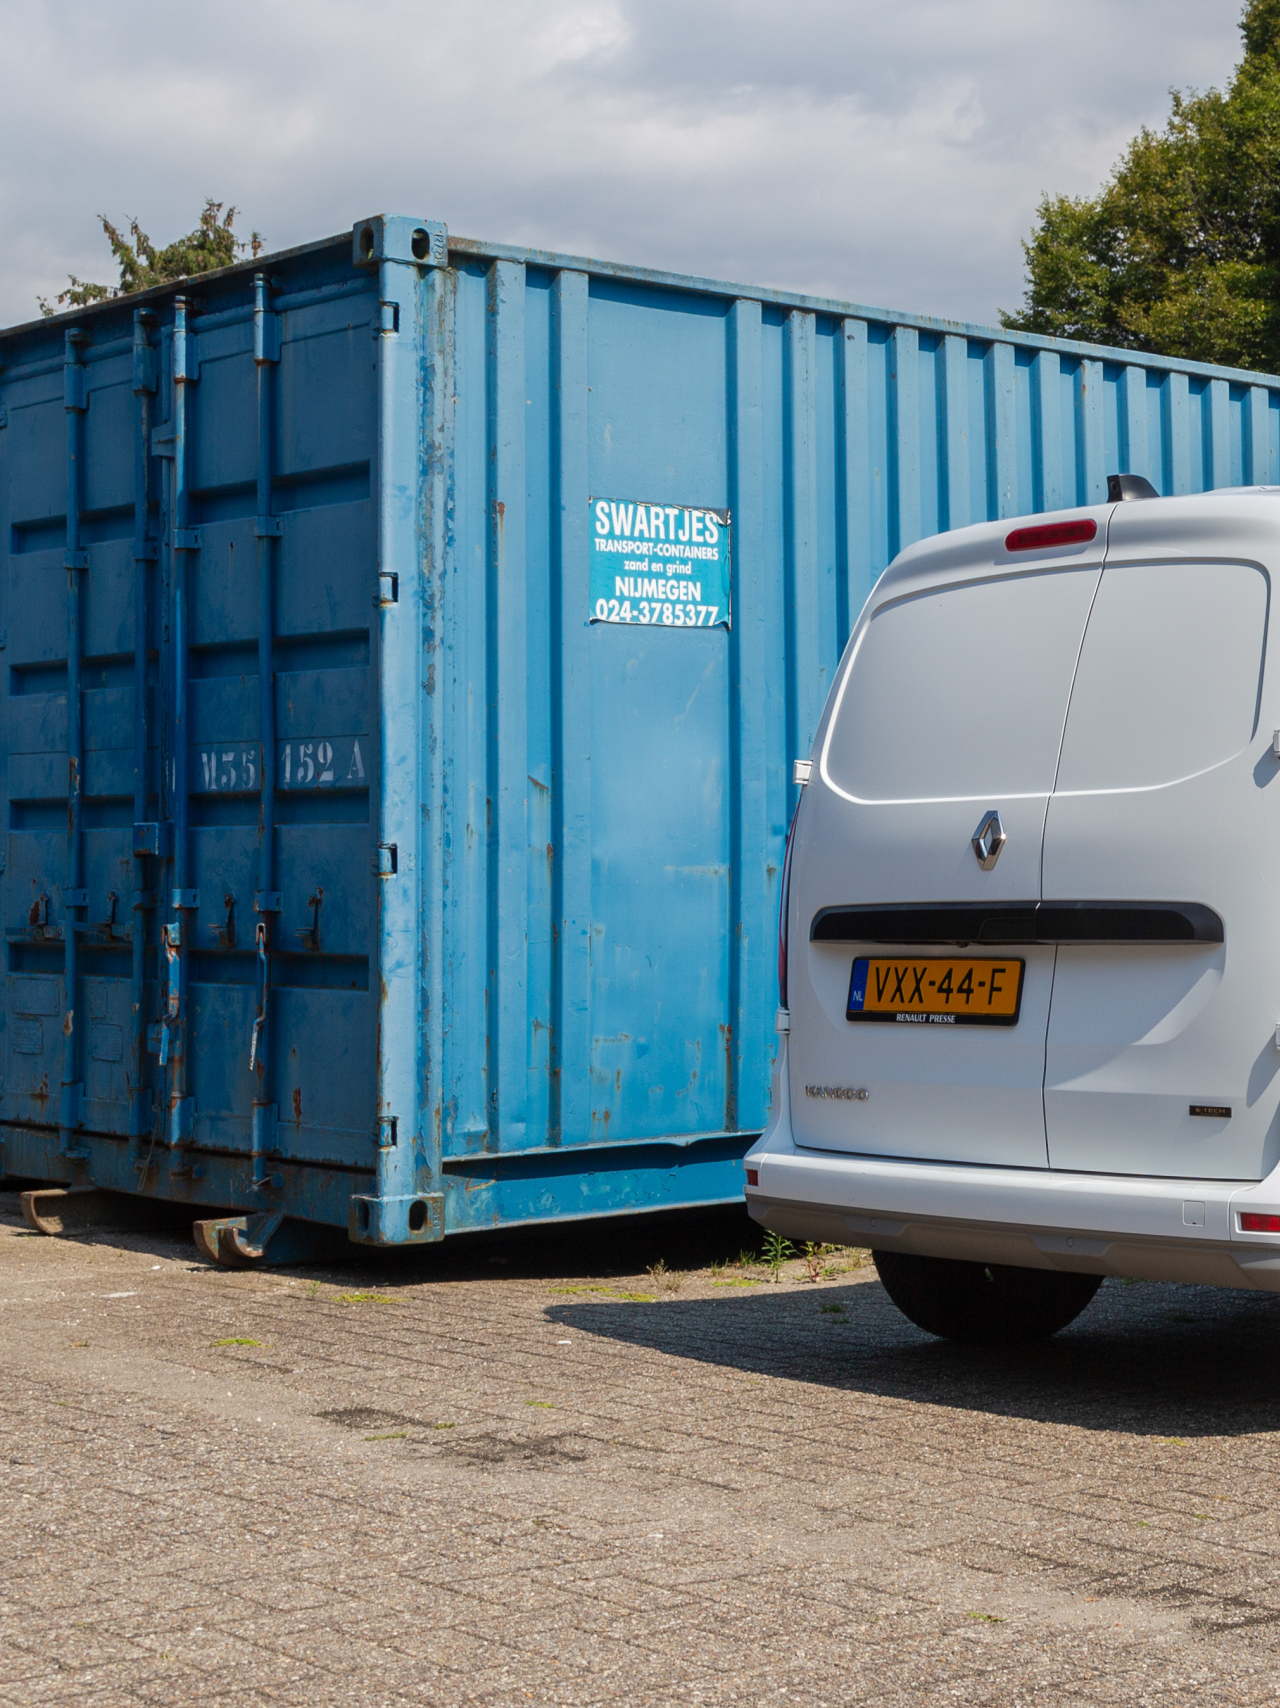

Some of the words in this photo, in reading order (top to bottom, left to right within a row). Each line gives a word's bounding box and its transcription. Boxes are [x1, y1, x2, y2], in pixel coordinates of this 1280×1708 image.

[595, 501, 719, 544] SWARTJES
[594, 538, 719, 560] TRANSPORT-CONTAINERS
[624, 558, 648, 571] zand
[652, 563, 664, 573] en
[666, 561, 691, 576] grind
[615, 576, 701, 601] NIJMEGEN
[595, 599, 719, 626] 024-3785377
[282, 742, 334, 782] 152
[347, 738, 365, 779] A
[853, 990, 863, 1002] NL
[876, 966, 1006, 1005] VXX-44-F
[896, 1013, 927, 1023] RENAULT
[929, 1014, 956, 1024] PRESSE
[805, 1084, 869, 1101] KANGOO
